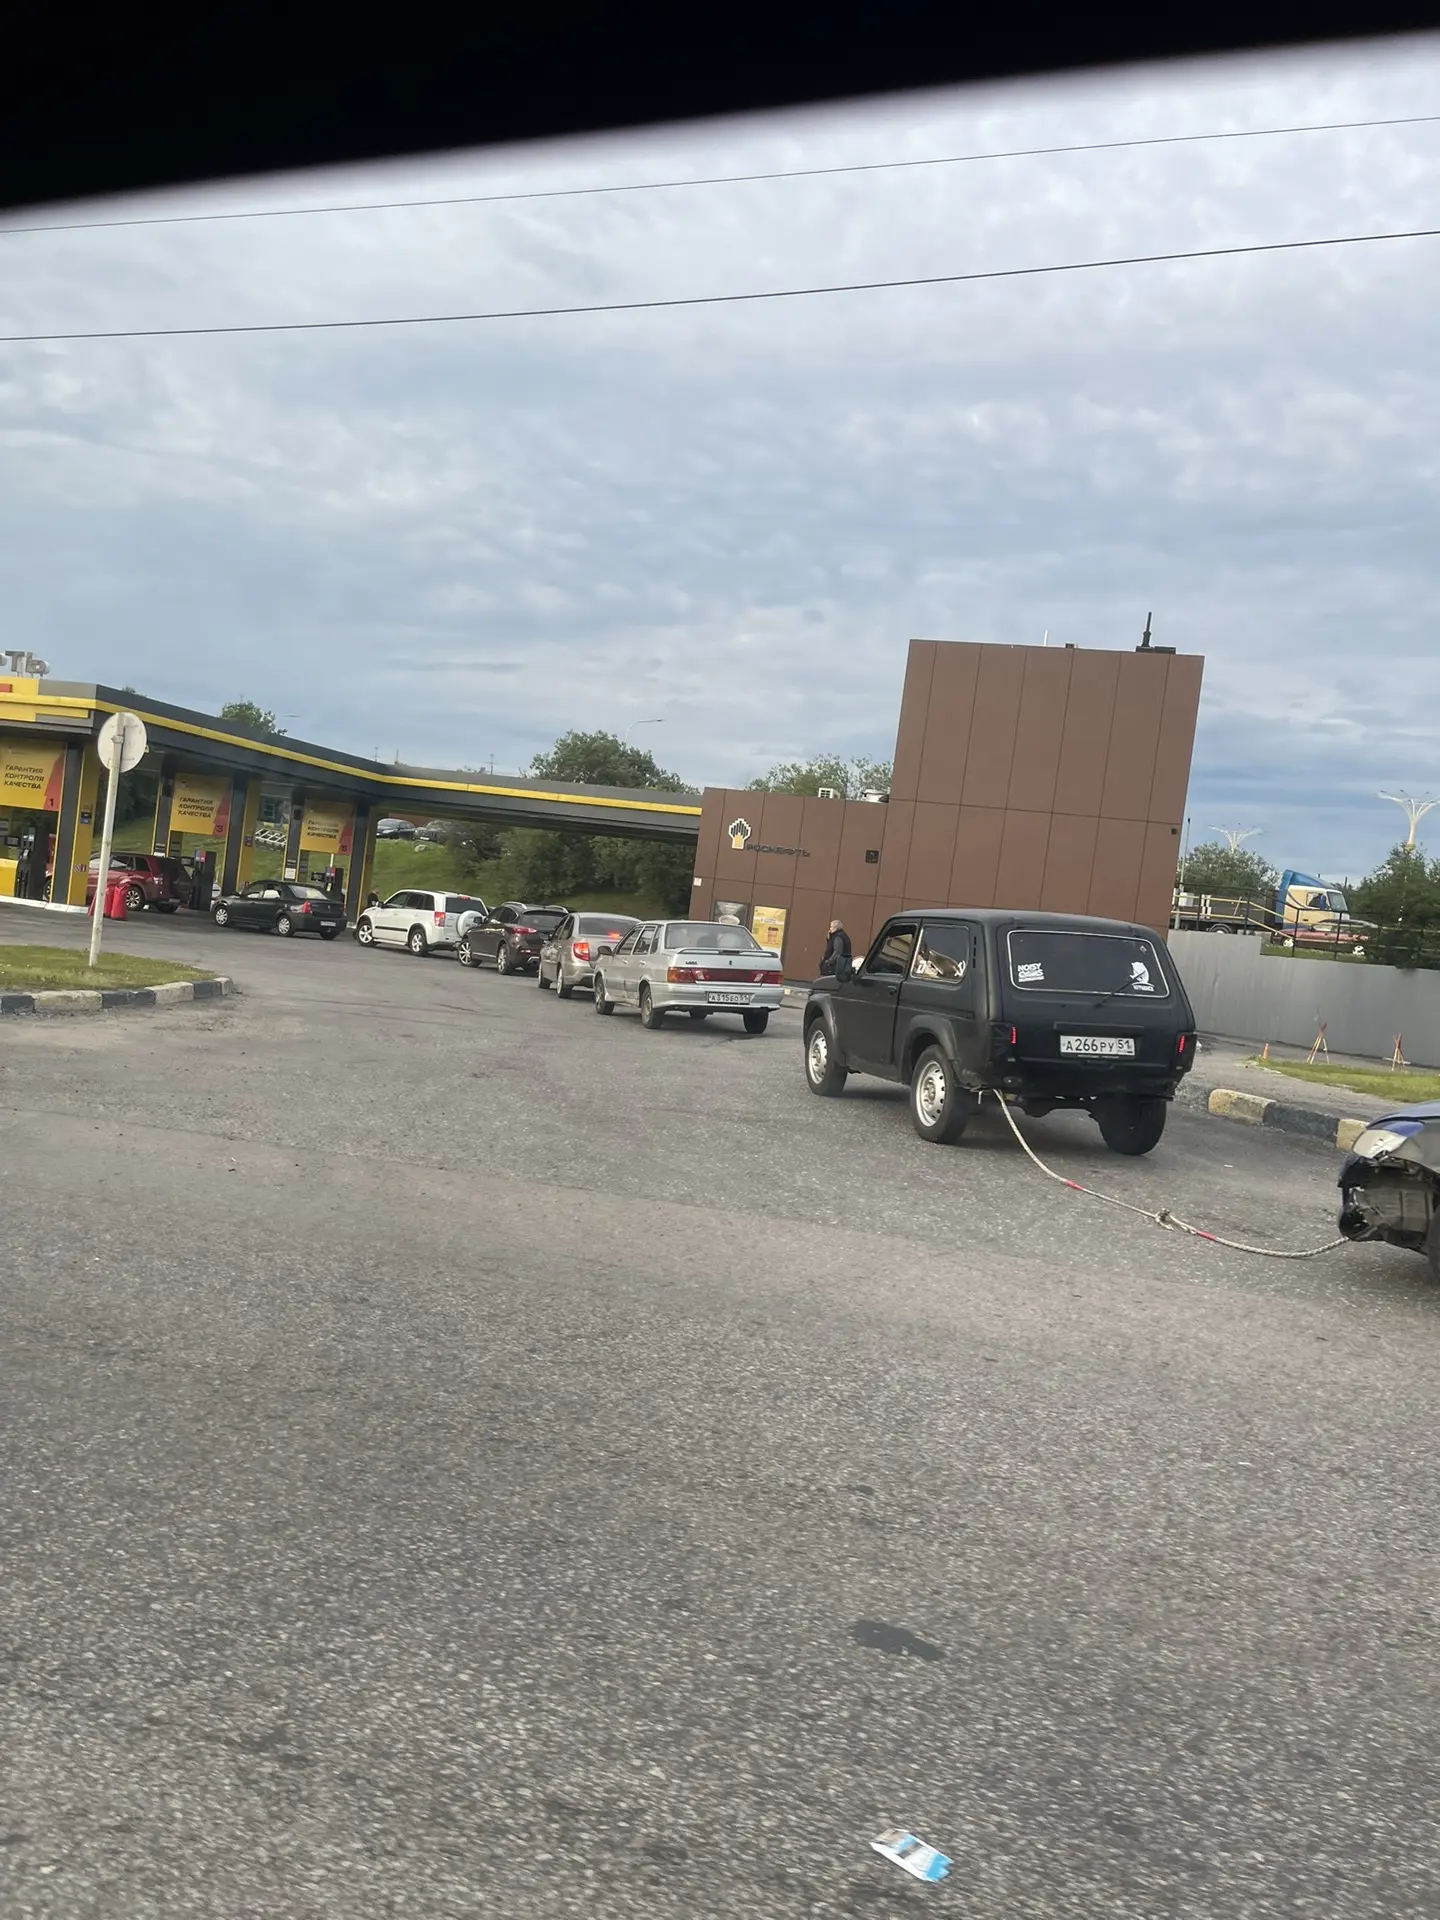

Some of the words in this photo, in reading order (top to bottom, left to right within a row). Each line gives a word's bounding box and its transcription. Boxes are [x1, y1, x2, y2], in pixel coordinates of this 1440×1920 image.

[5, 764, 44, 774] ГАРАНТИЯ
[4, 772, 45, 782] КОНТРОЛЯ
[4, 780, 42, 790] КАЧЕСТВА
[49, 798, 54, 807] 1
[215, 824, 224, 833] 3
[746, 844, 810, 857] РОСНЕФТЬ
[1065, 1038, 1114, 1053] А266РУ
